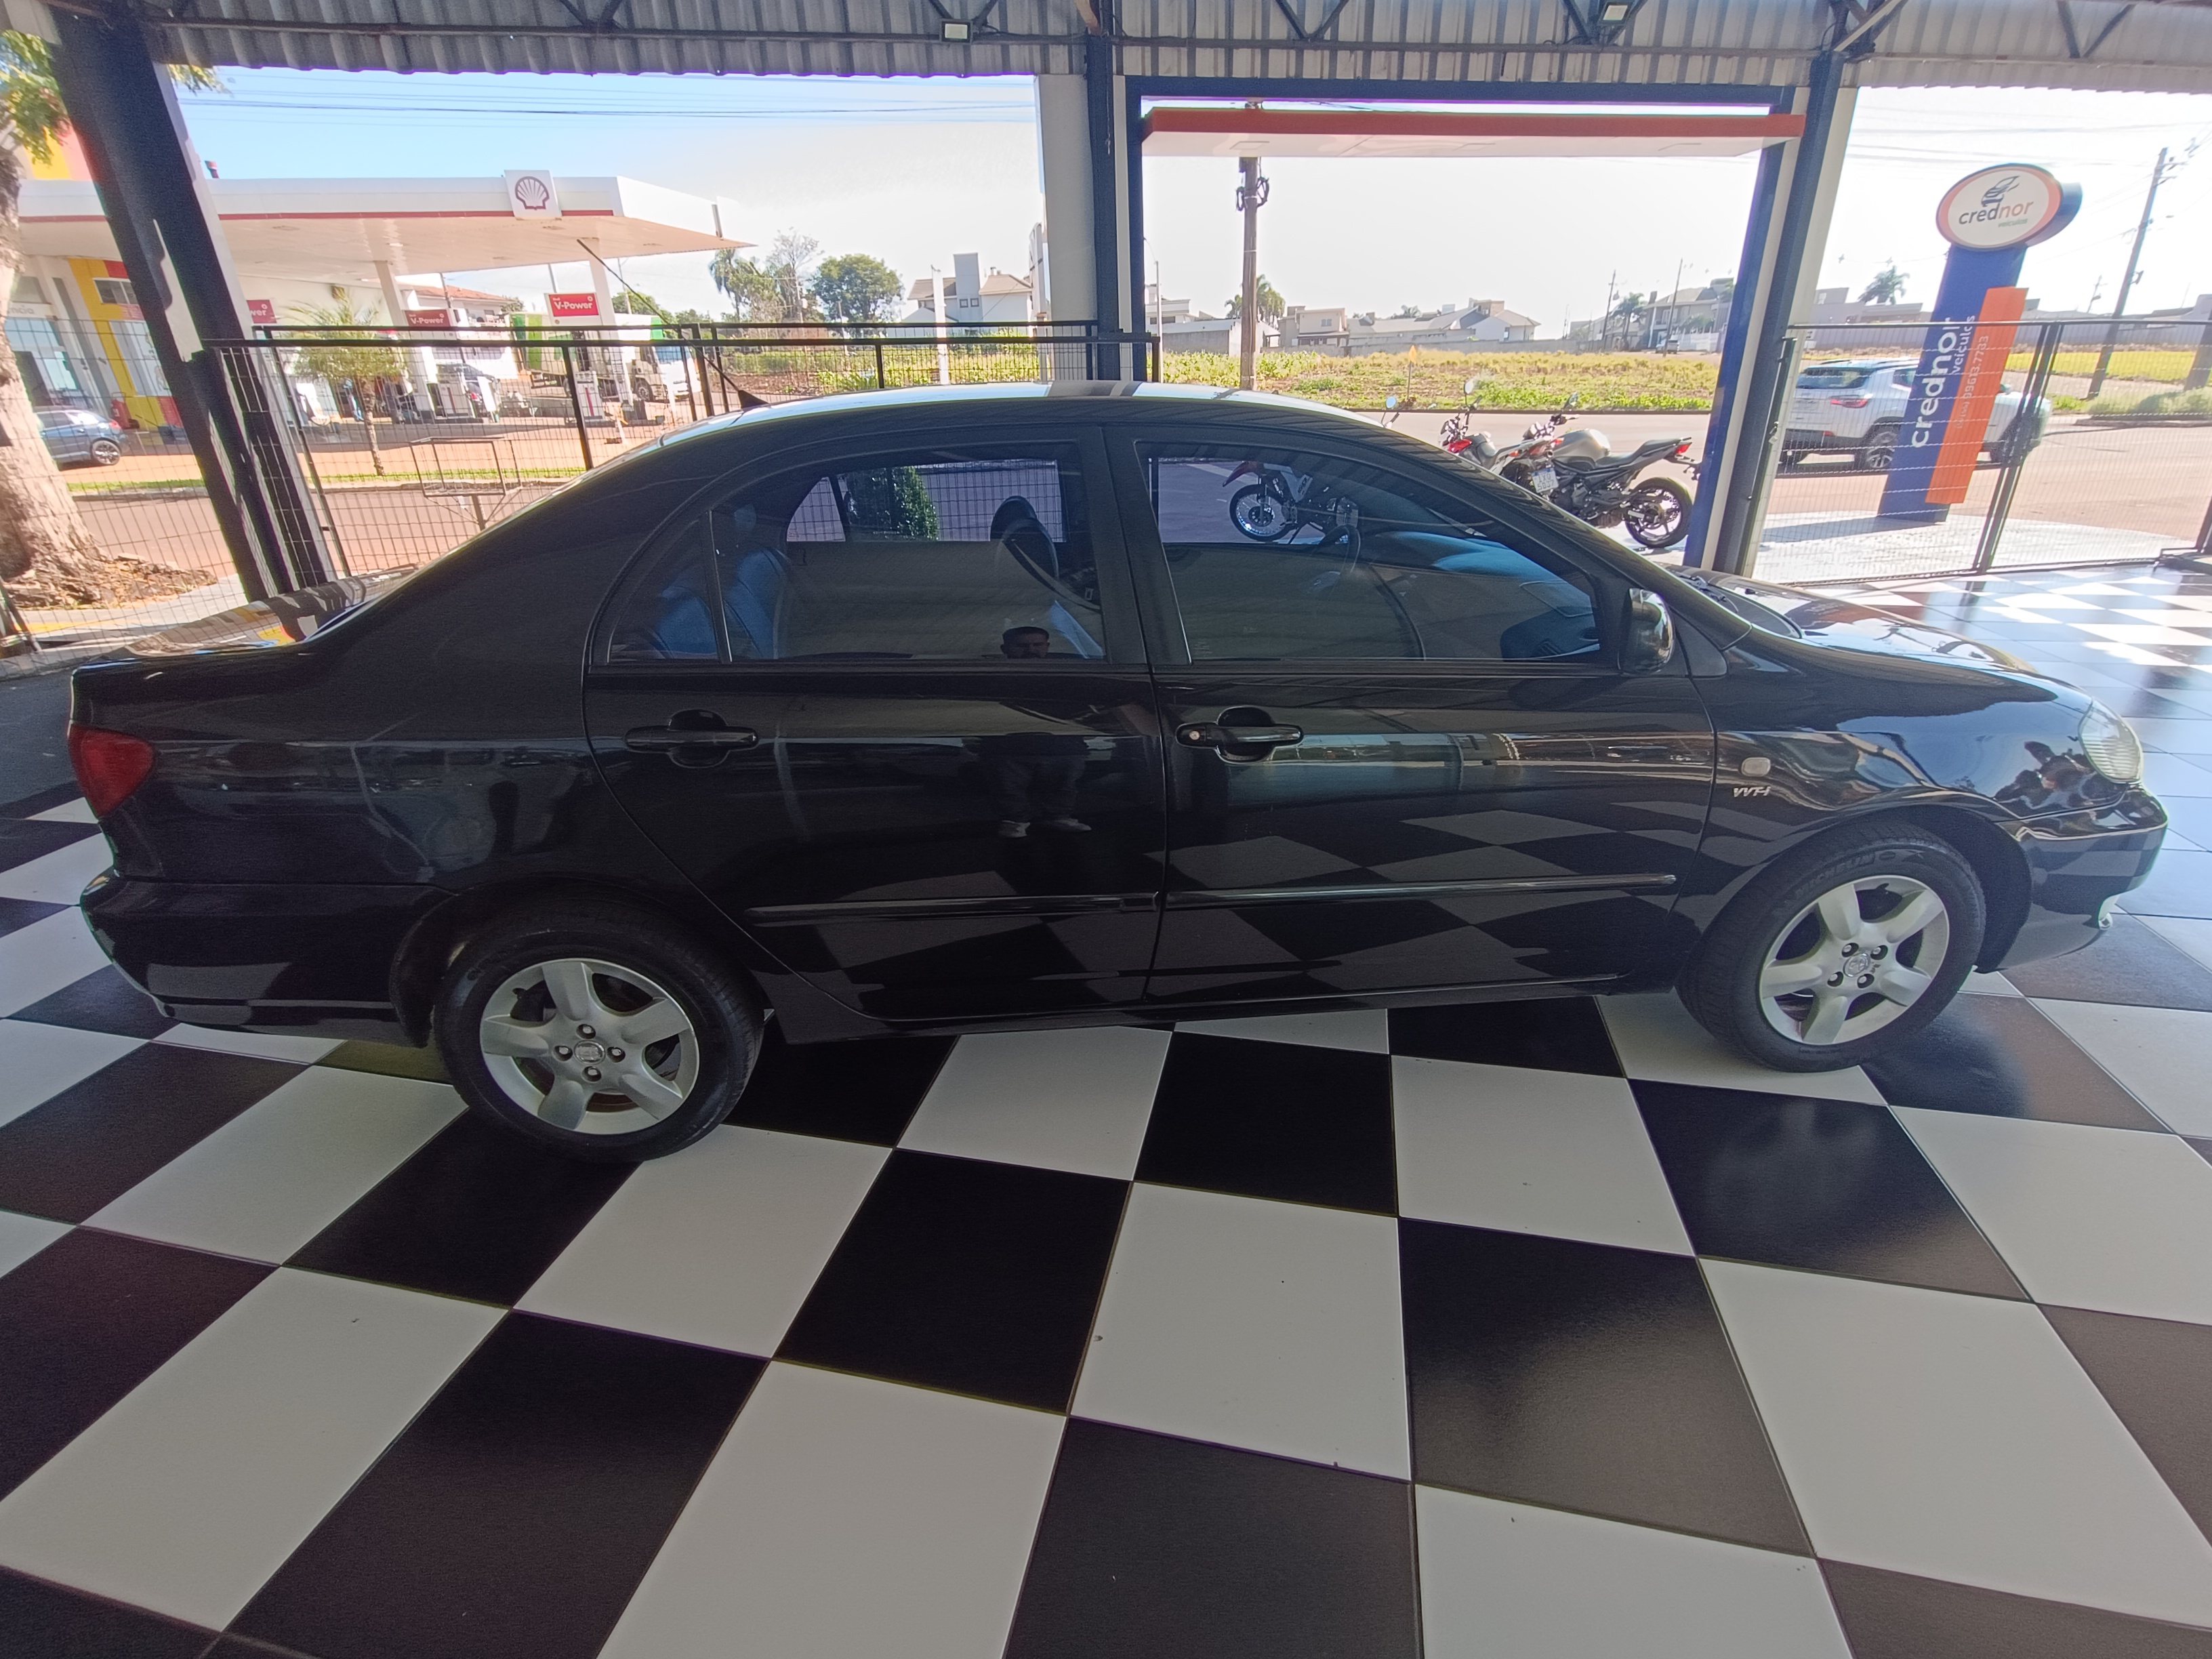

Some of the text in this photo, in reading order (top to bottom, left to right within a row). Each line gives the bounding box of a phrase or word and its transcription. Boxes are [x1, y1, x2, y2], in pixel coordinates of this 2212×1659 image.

[1959, 201, 2034, 225] crednor
[553, 301, 593, 310] V-Power
[1911, 316, 1961, 448] crednor
